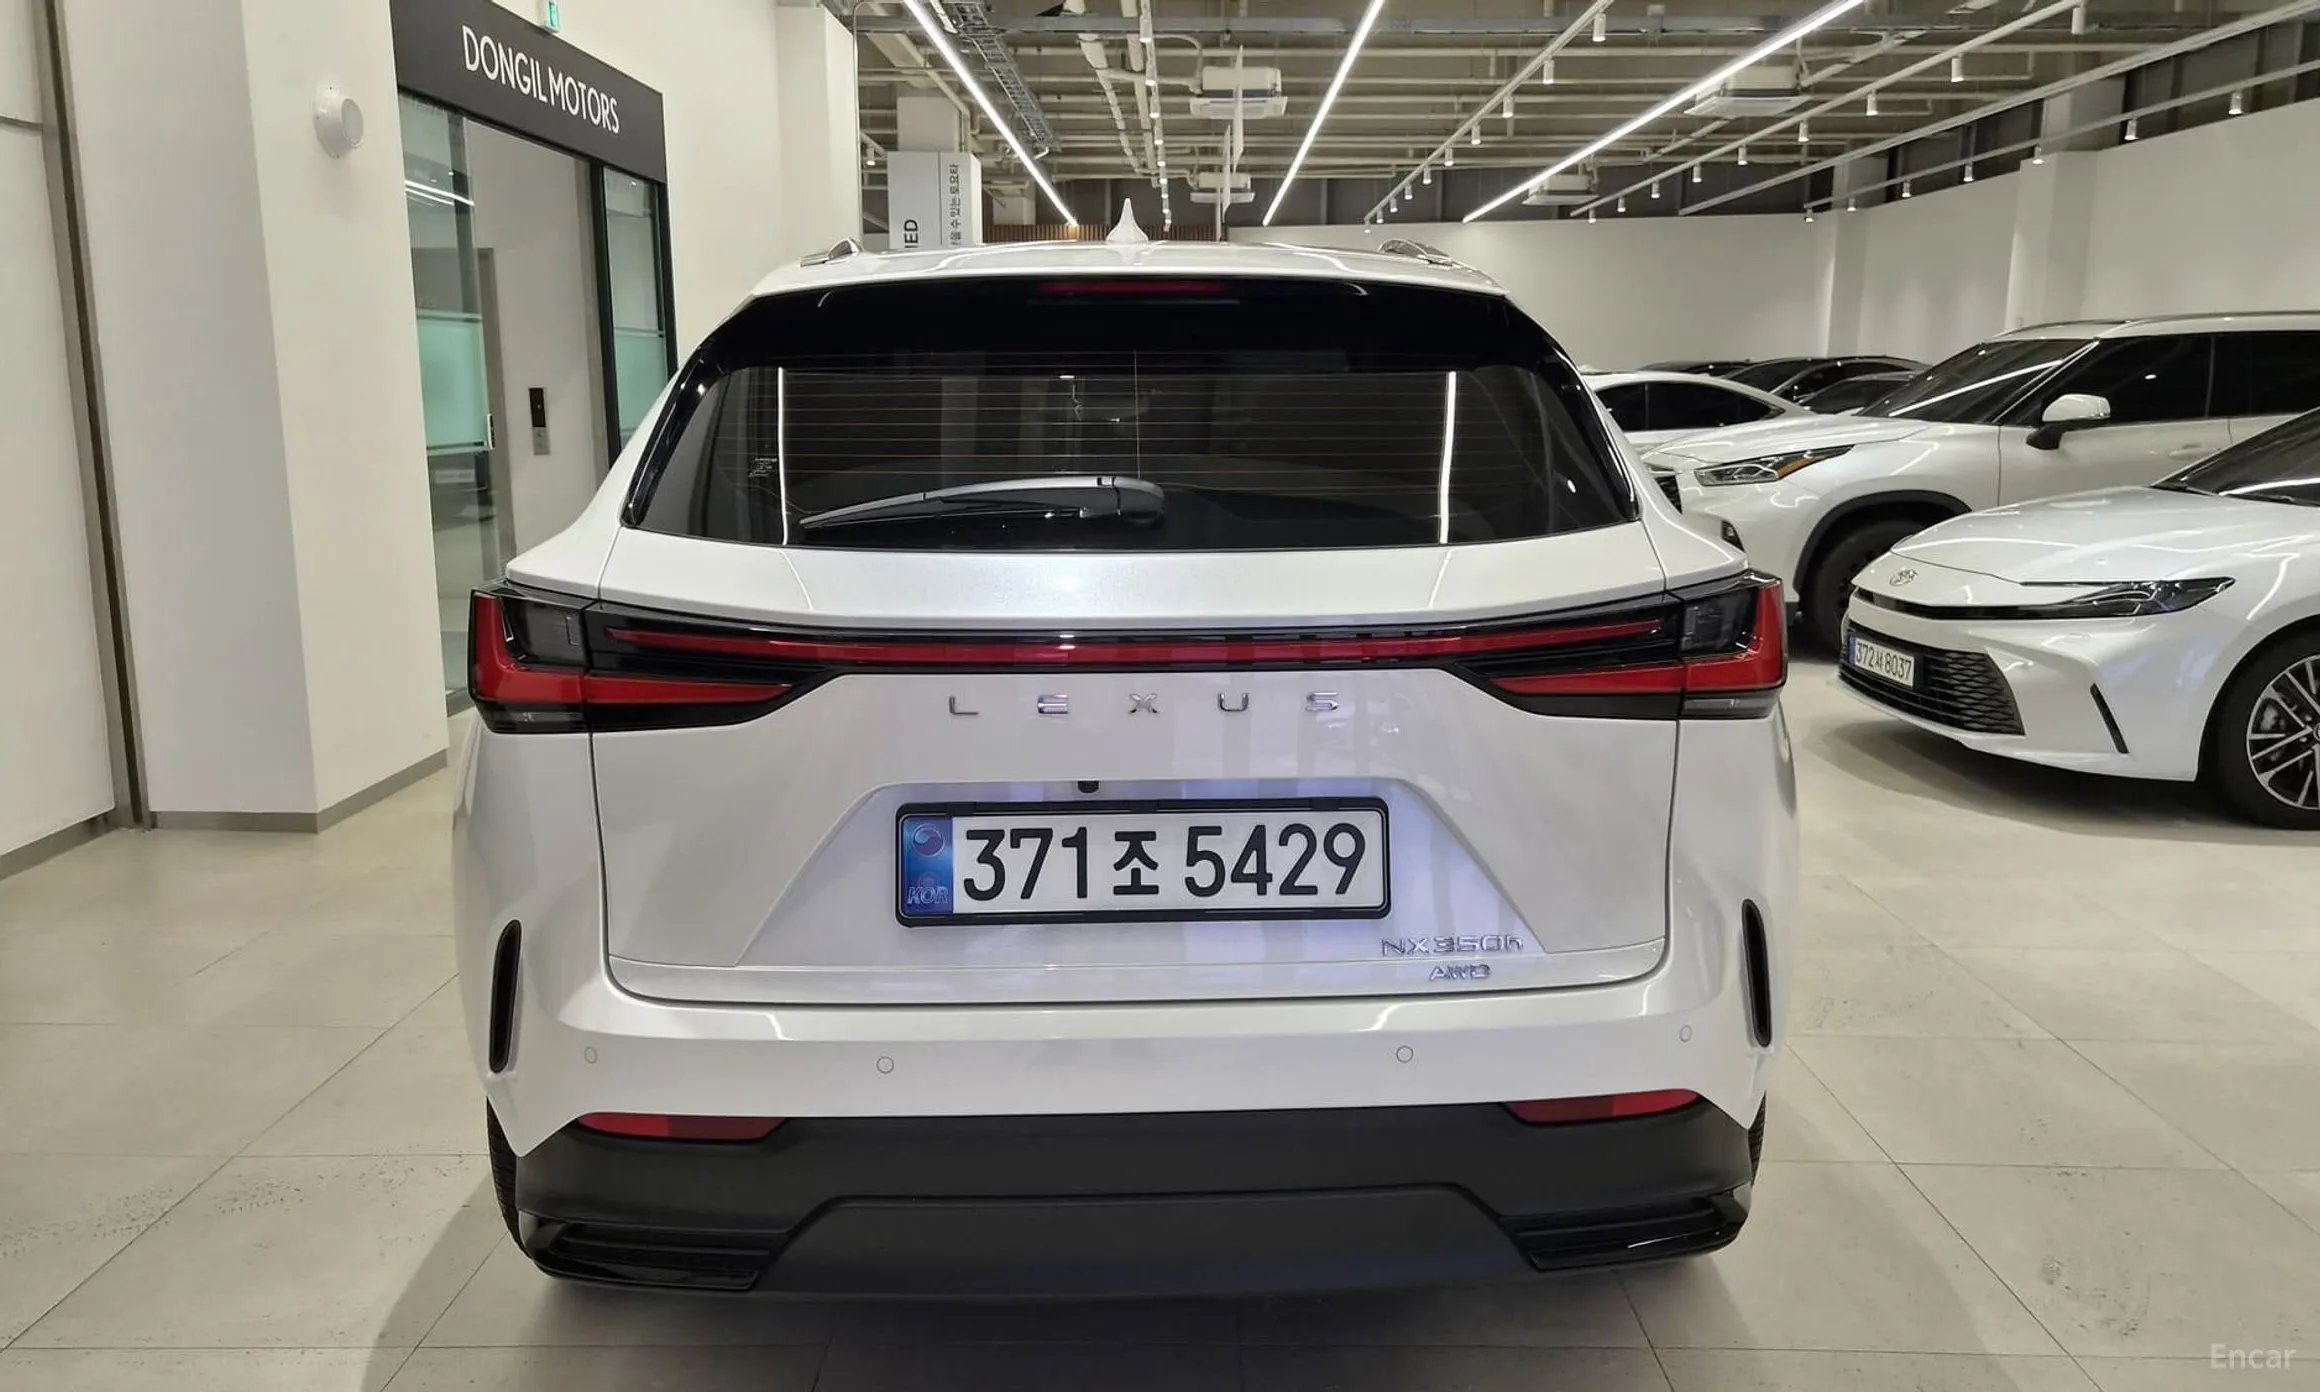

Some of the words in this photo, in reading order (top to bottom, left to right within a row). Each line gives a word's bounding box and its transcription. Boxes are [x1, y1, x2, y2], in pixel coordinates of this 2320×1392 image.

[462, 25, 548, 104] DONGIL
[549, 66, 620, 134] MOTORS
[949, 692, 1339, 715] LEXUS
[907, 886, 949, 904] KOR
[1429, 964, 1491, 981] AWD
